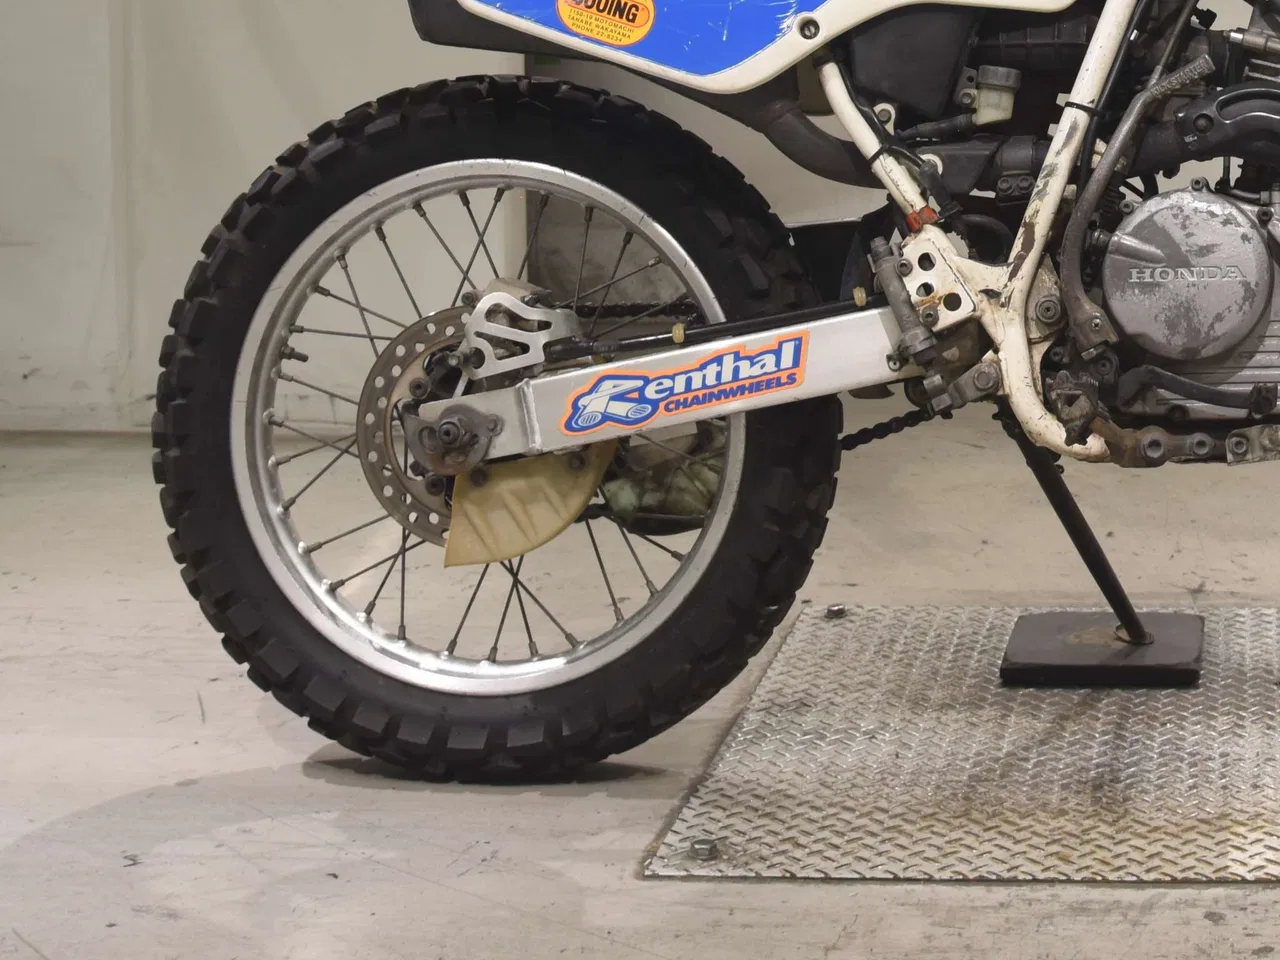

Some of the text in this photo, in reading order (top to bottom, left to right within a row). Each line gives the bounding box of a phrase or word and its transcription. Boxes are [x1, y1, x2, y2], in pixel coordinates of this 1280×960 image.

[1128, 265, 1247, 283] HONDA
[572, 336, 803, 429] Renthal
[663, 371, 799, 414] CHAINWHEELS
